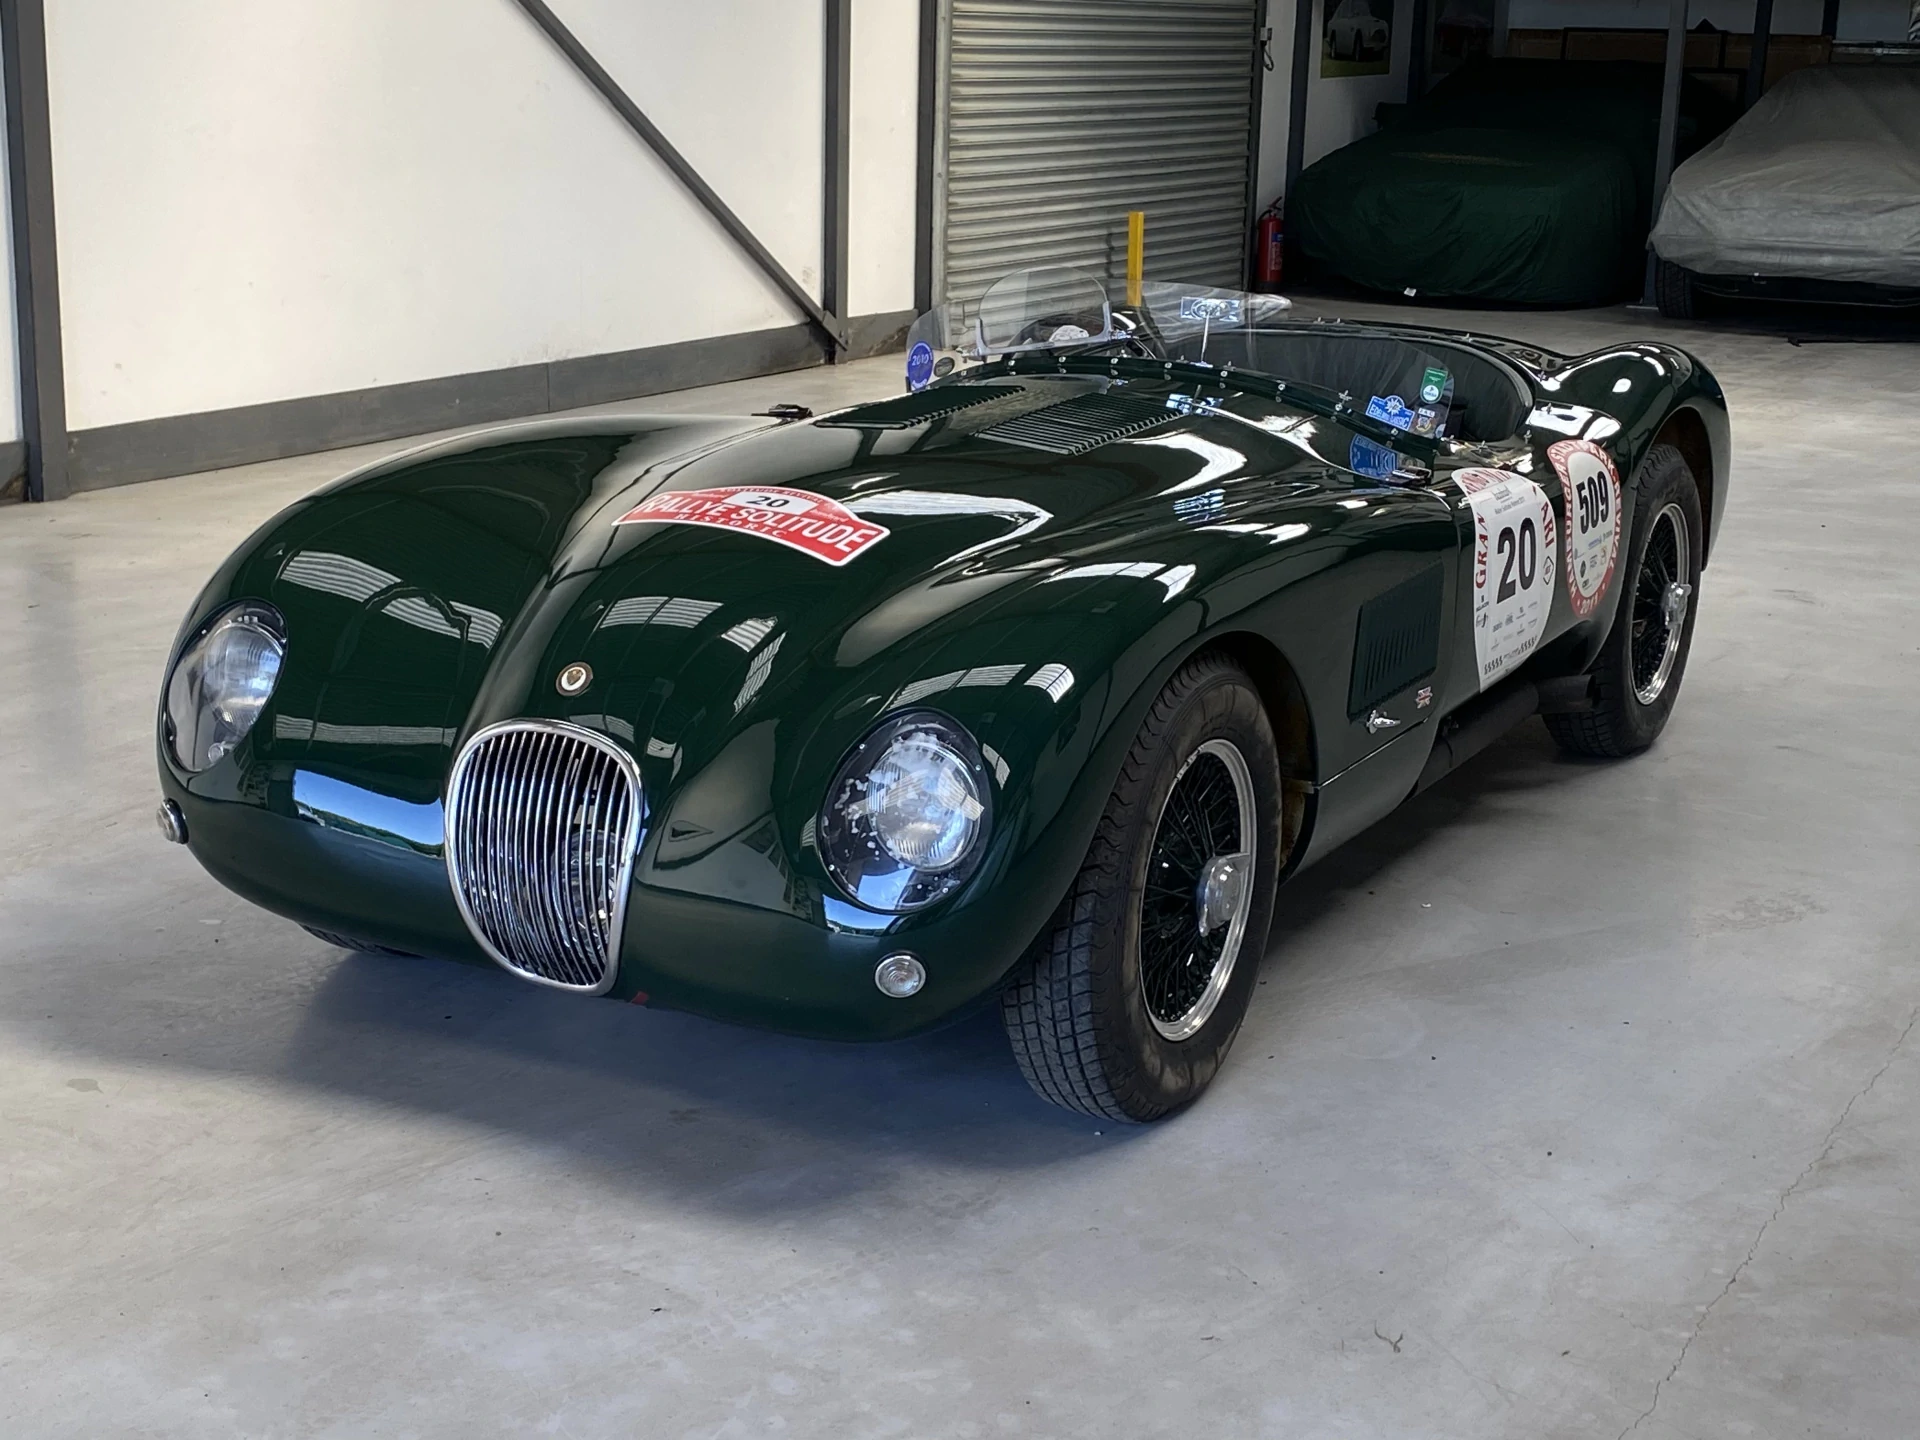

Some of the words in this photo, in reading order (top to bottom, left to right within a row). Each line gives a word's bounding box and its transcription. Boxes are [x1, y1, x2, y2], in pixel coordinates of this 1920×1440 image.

[634, 494, 736, 517] RALLYE
[731, 506, 878, 553] SOLITUDE
[674, 513, 788, 538] HISTORIC
[746, 495, 790, 508] 20
[1575, 471, 1609, 535] 509
[1474, 512, 1489, 589] GRAN
[1496, 517, 1536, 604] 20
